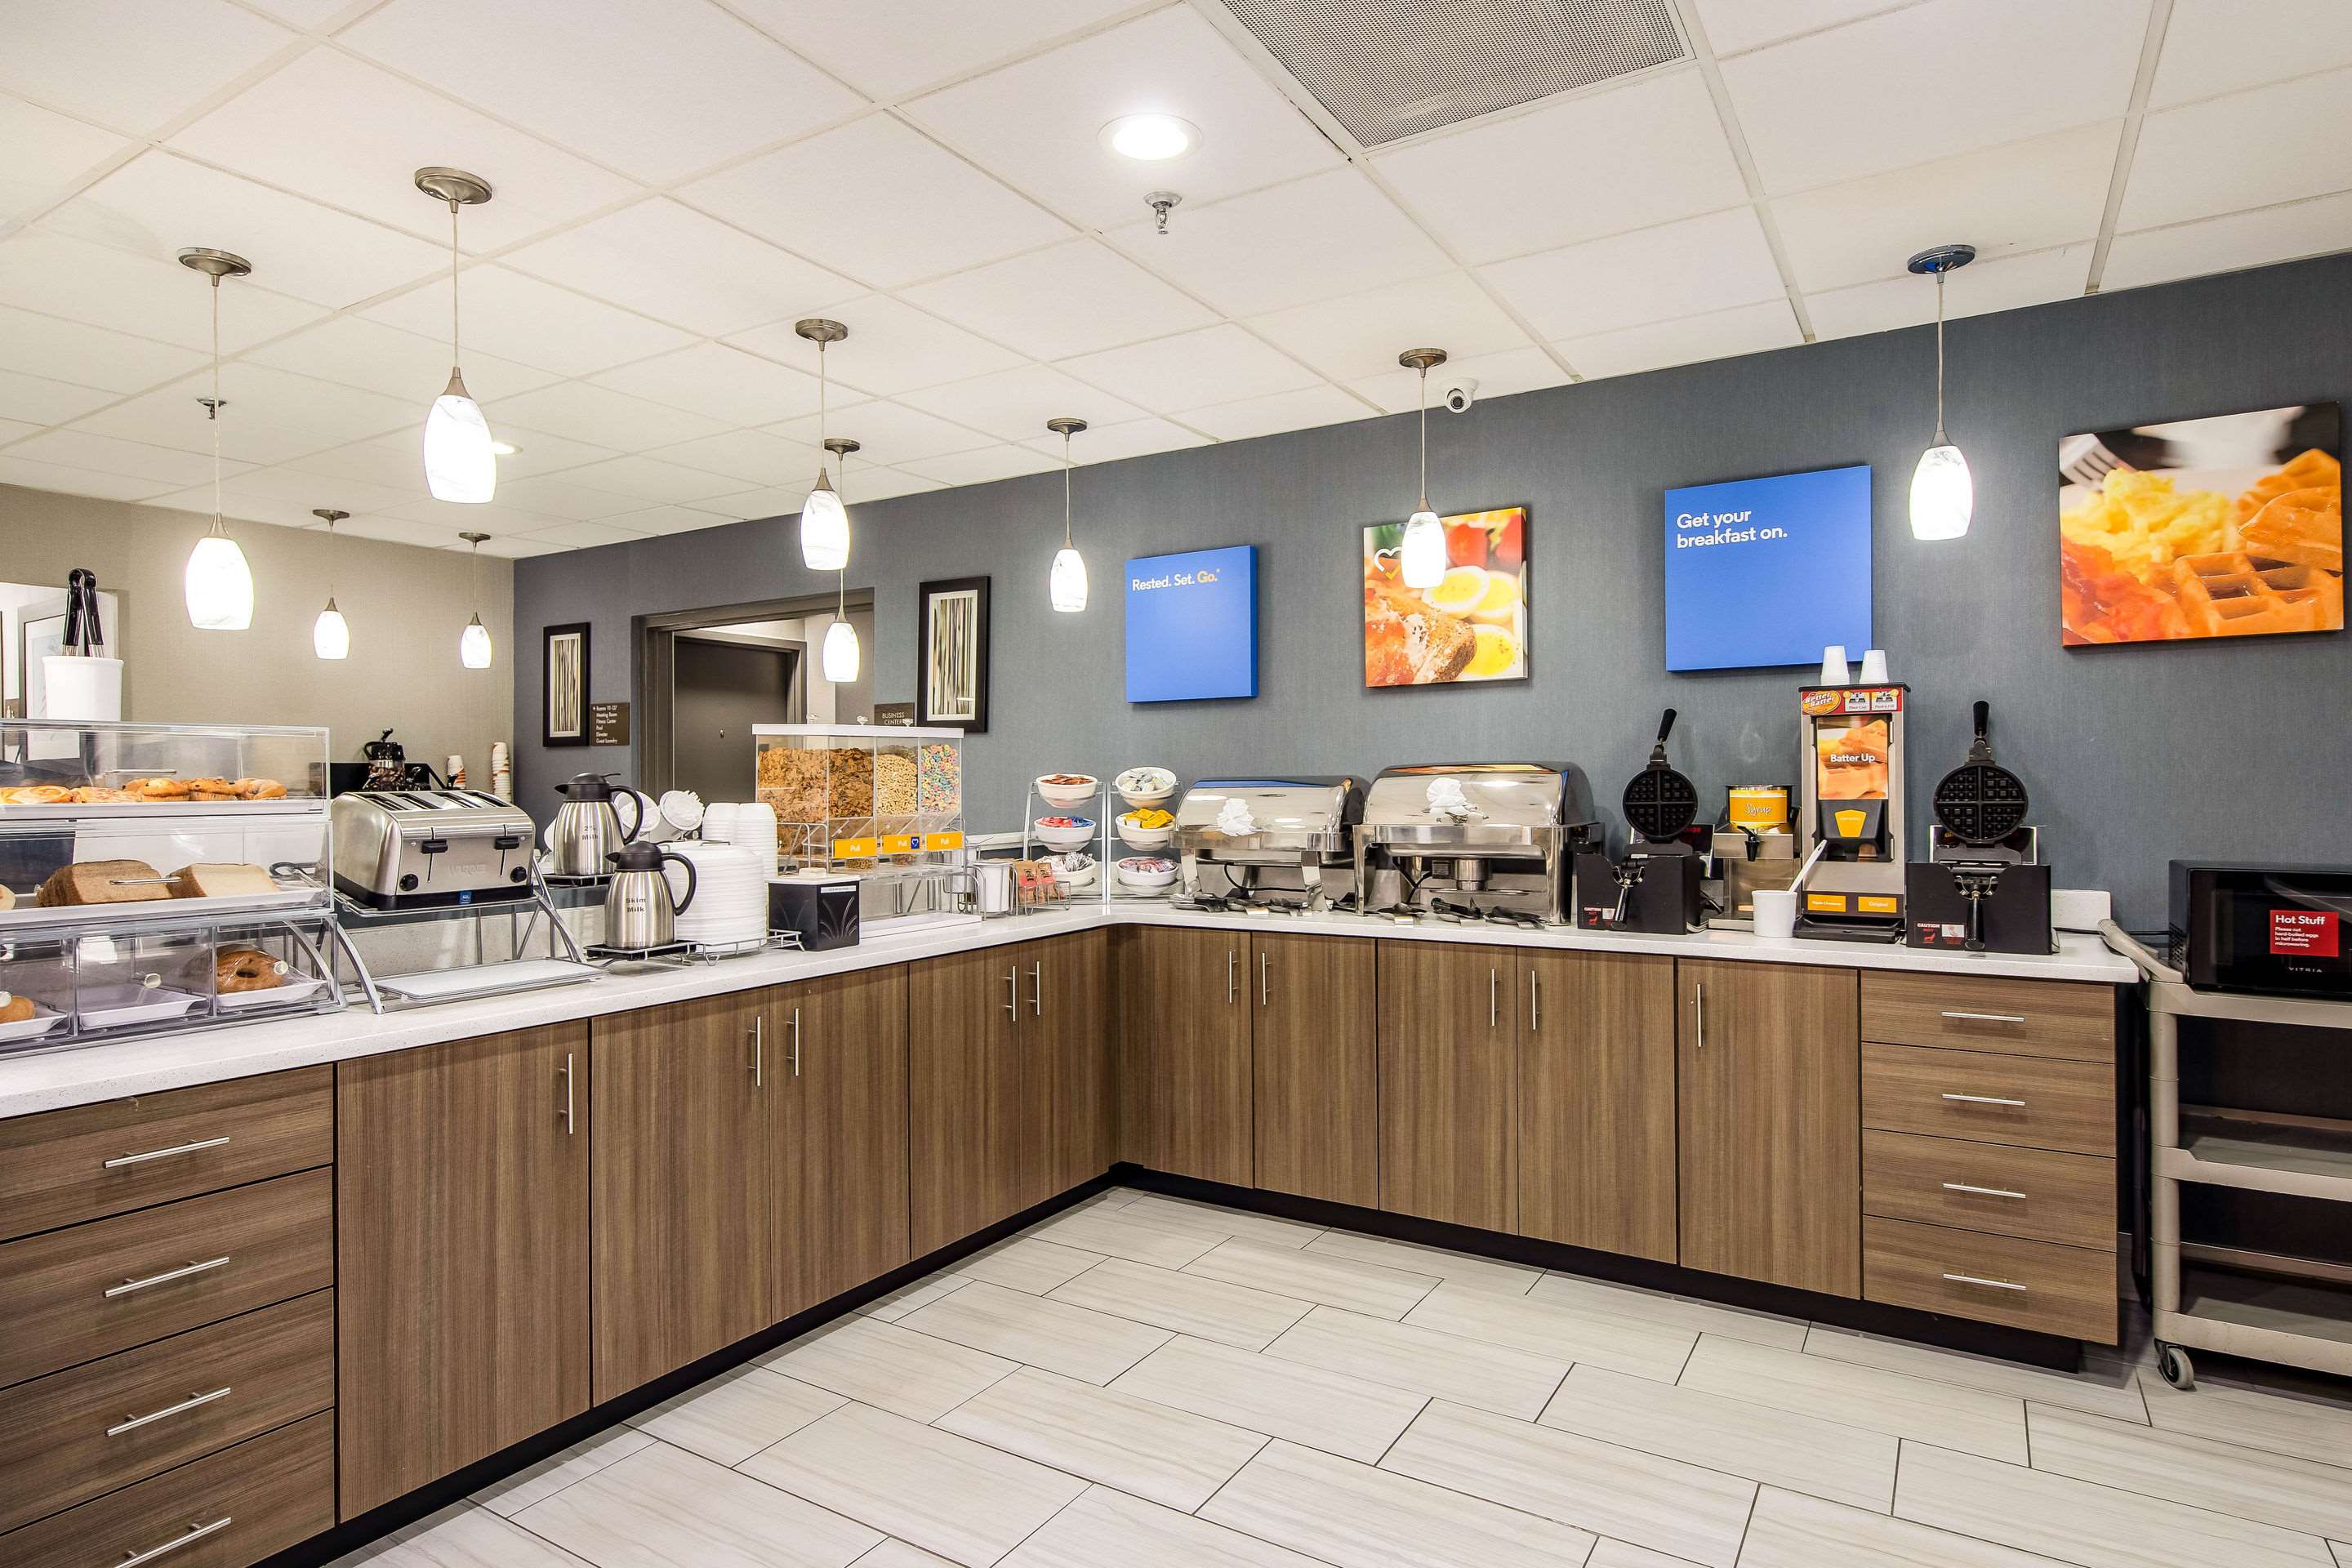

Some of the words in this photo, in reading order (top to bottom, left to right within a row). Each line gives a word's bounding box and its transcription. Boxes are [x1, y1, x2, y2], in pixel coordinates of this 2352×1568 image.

[1677, 513, 1709, 529] Get
[1713, 510, 1752, 528] your
[1677, 527, 1757, 549] breakfast
[1760, 527, 1788, 540] on.
[1132, 575, 1172, 591] Rested.
[1174, 573, 1195, 586] Set.
[1830, 754, 1860, 763] Batter
[1861, 753, 1876, 764] Up
[1744, 803, 1772, 817] Syrup
[2274, 915, 2296, 924] Hot
[2298, 915, 2326, 925] Stuff
